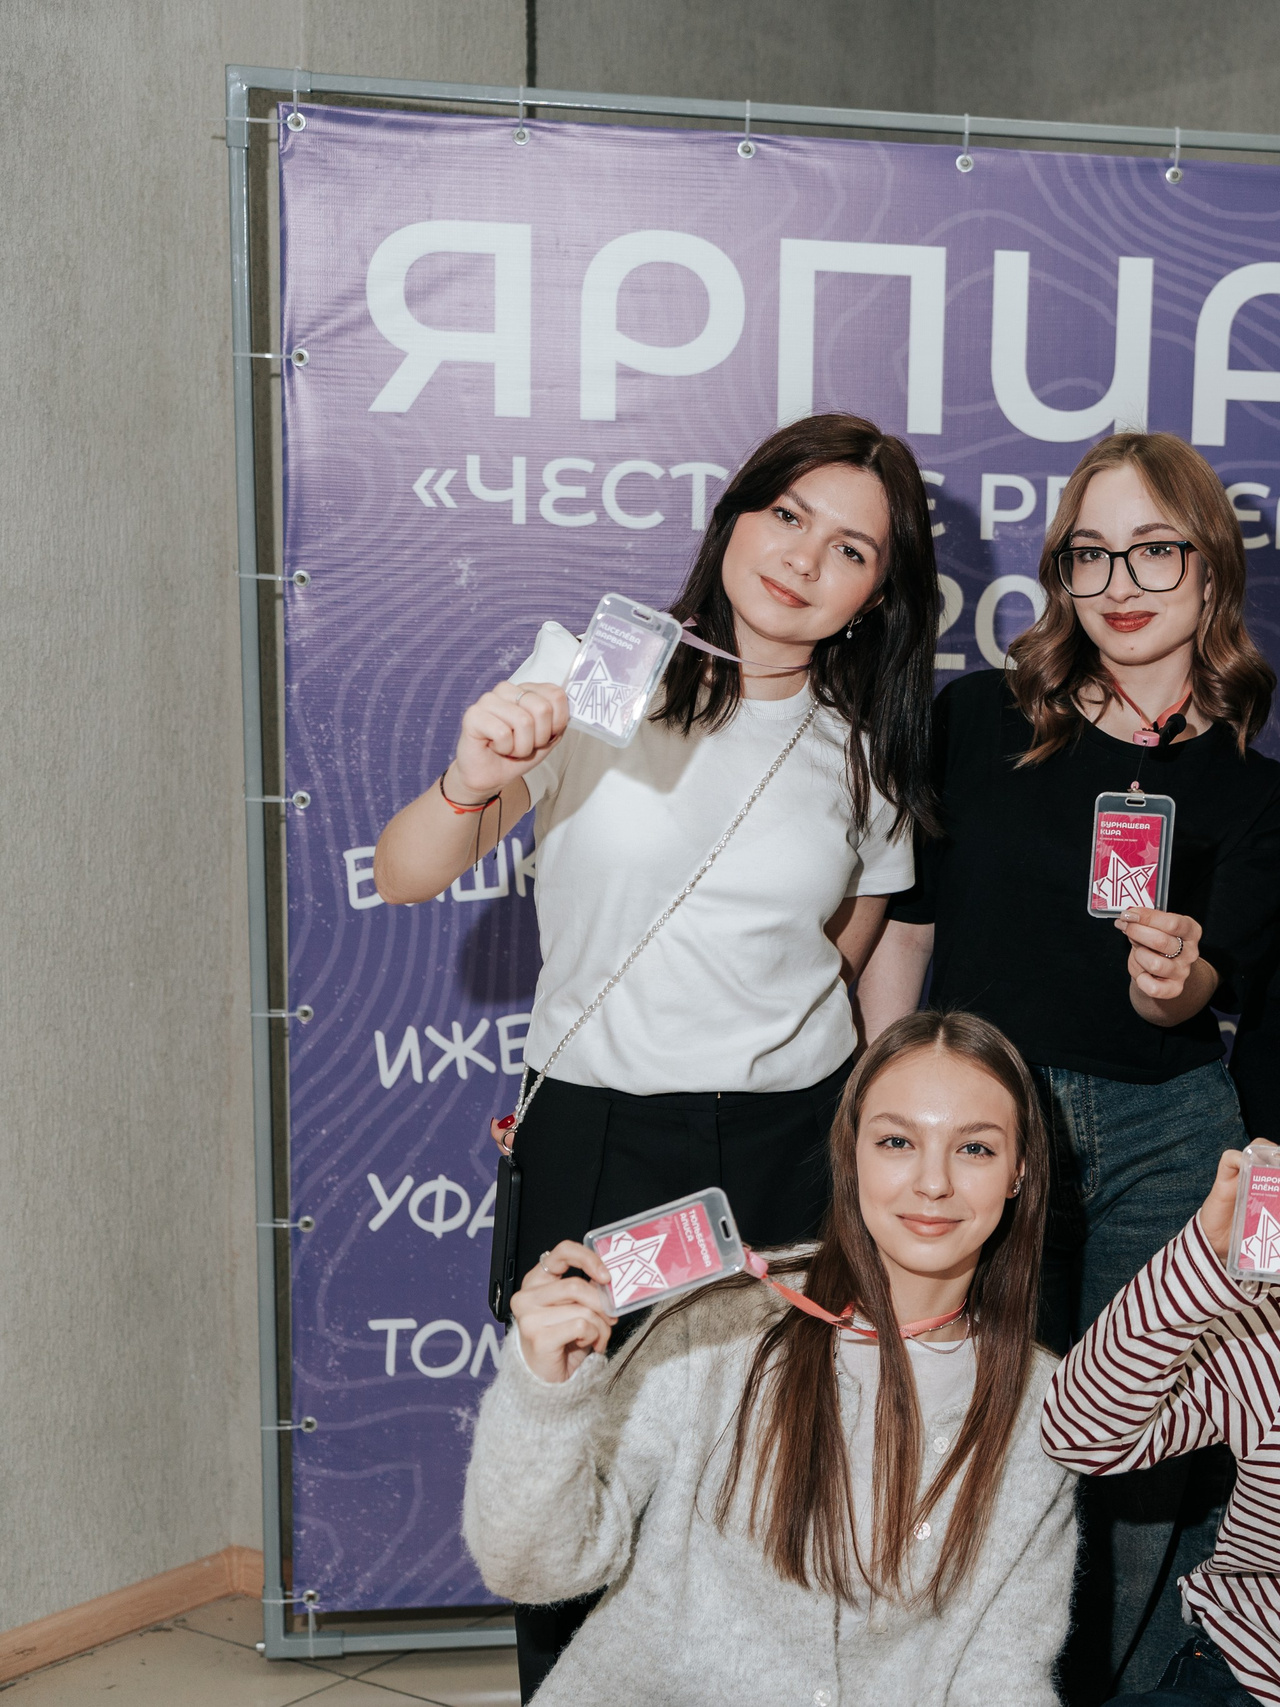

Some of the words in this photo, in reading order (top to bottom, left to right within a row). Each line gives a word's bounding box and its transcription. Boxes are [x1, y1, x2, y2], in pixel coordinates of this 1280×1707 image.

[595, 630, 634, 651] ВАРВАРА
[1100, 820, 1150, 830] БУРНАШЕВА
[1251, 1183, 1280, 1192] АЛЁНА
[680, 1213, 694, 1242] АЛИСА
